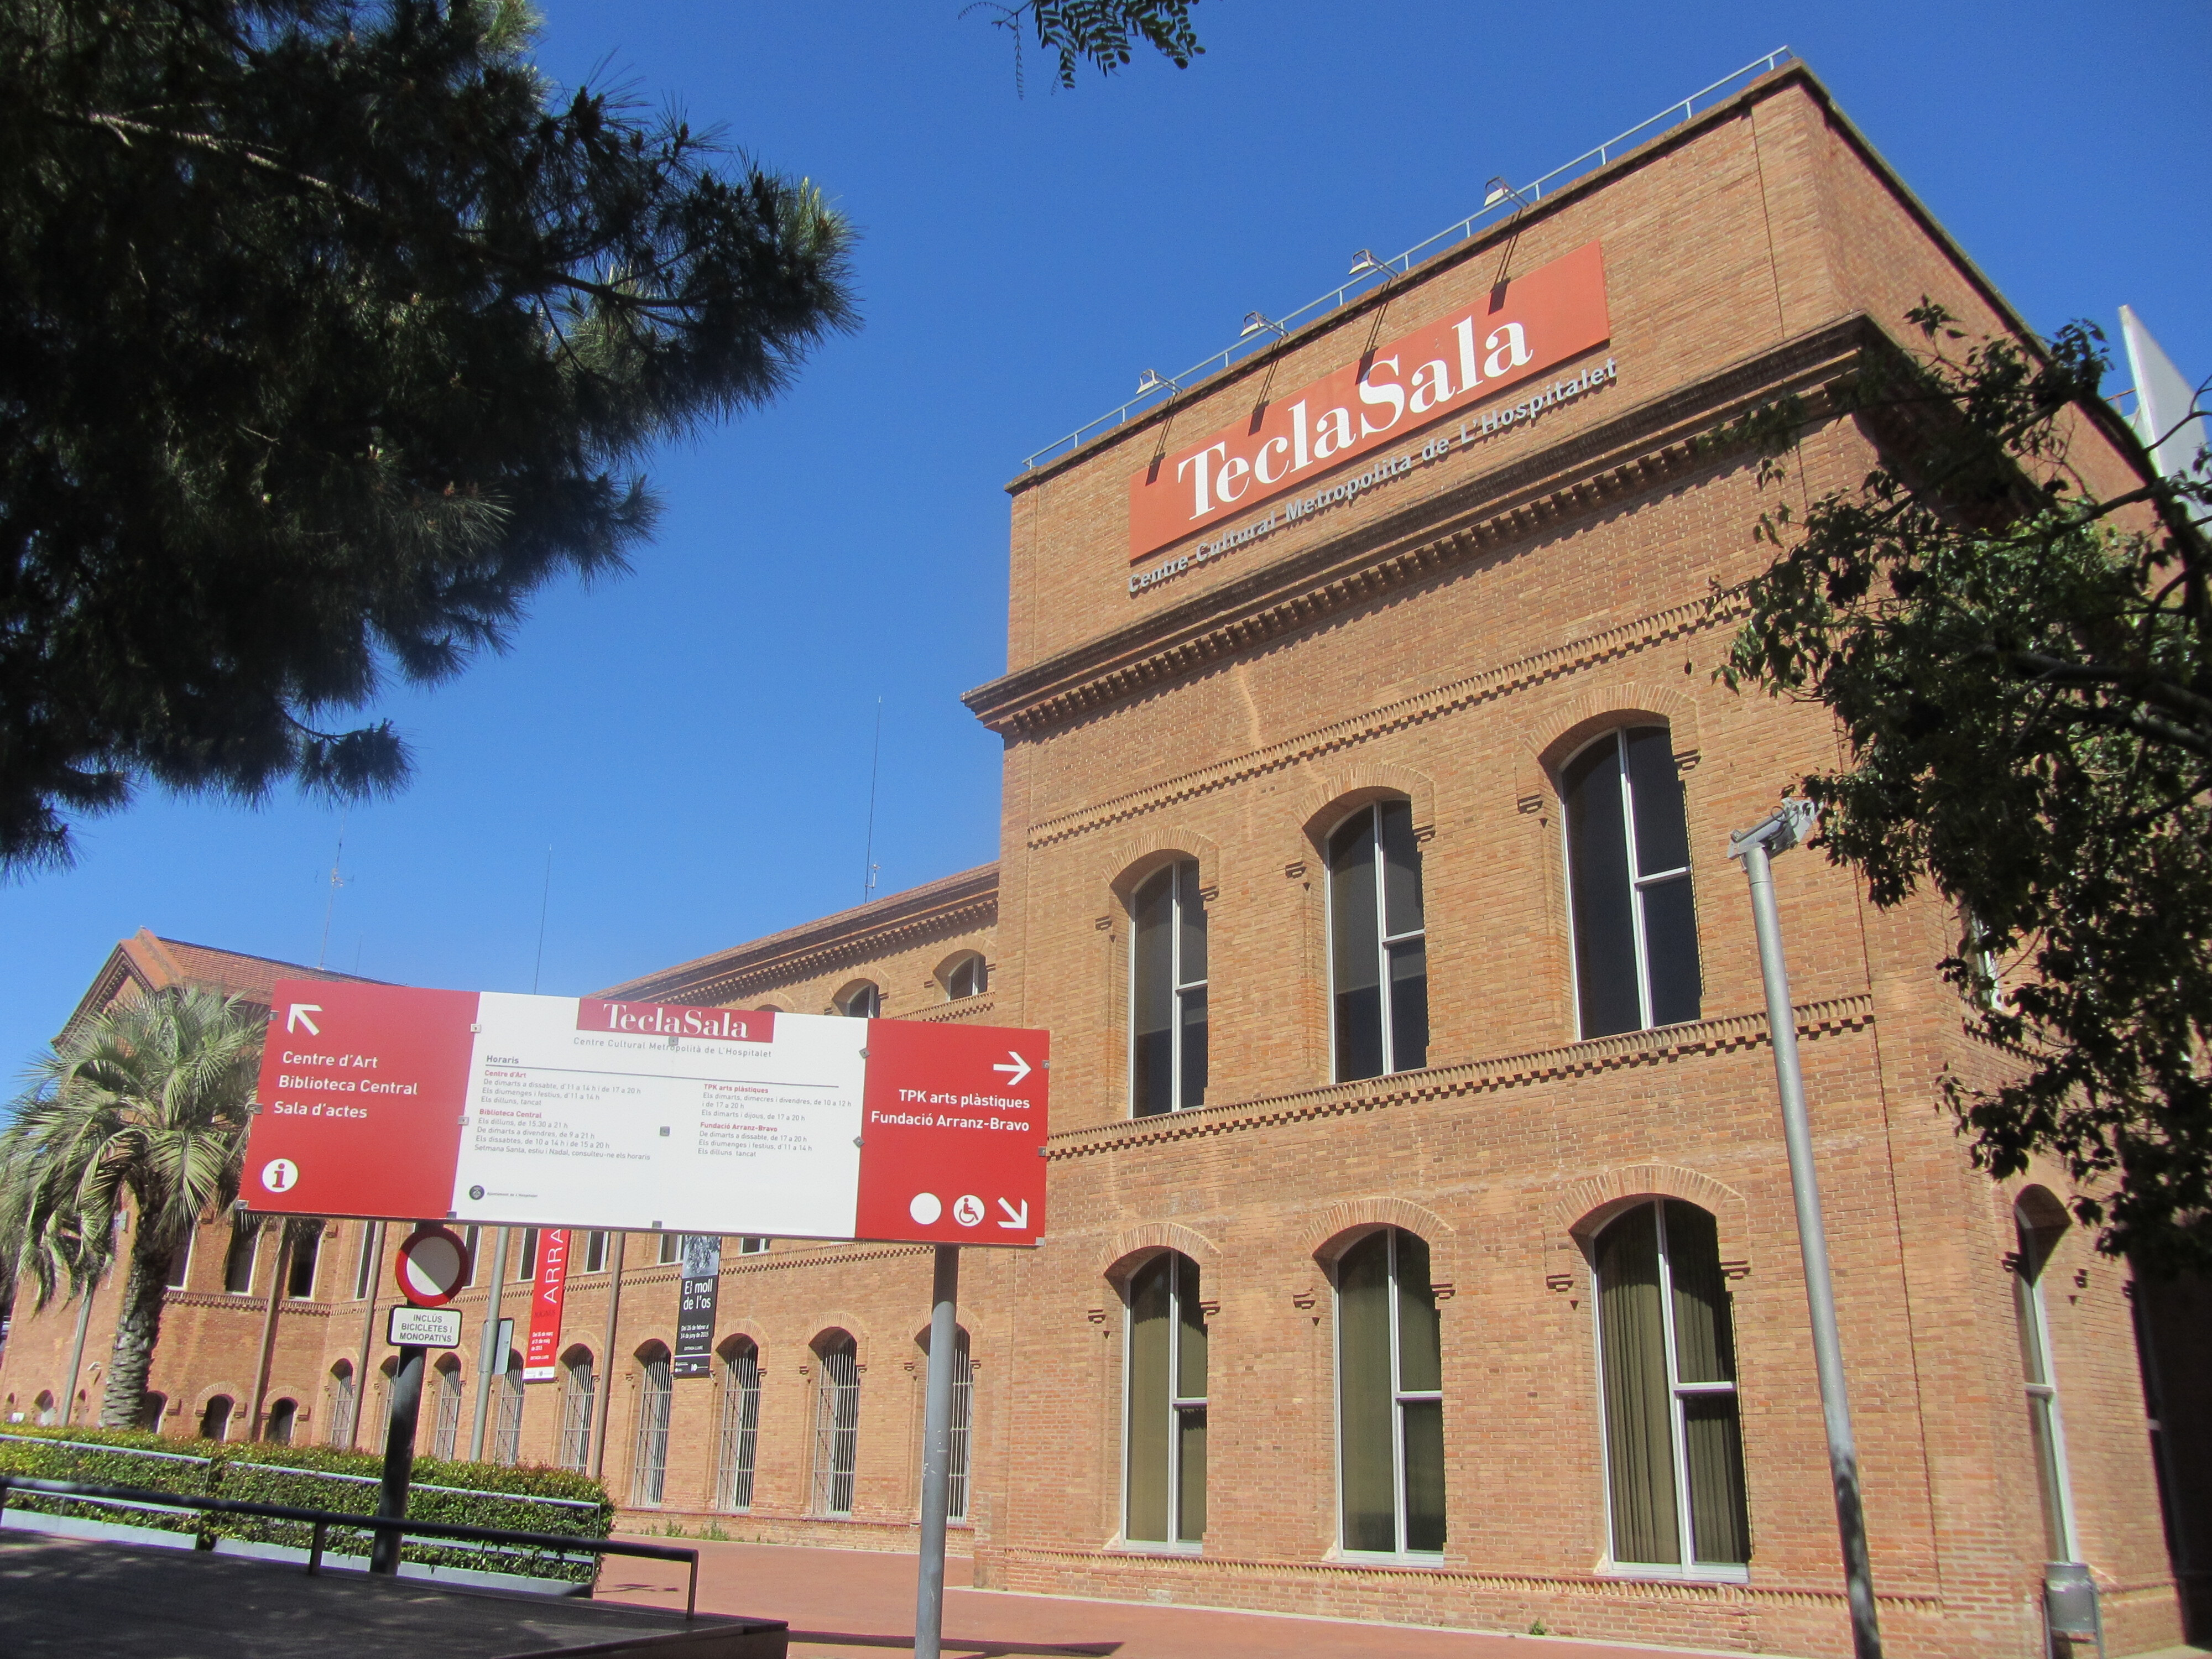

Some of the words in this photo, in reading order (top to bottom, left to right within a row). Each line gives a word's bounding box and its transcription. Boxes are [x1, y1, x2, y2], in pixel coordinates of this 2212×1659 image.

[1178, 315, 1533, 520] TeclaSala
[1129, 554, 1188, 593] Centre
[1196, 511, 1276, 562] Cultural
[1286, 455, 1412, 522] Metropolita
[1421, 438, 1449, 461] de
[1460, 357, 1617, 444] L'Hospitalet
[603, 1003, 749, 1038] TeclaSala
[573, 1037, 604, 1046] Centre
[608, 1039, 645, 1048] Cultural
[718, 1047, 770, 1057] L'Hospitalet
[283, 1051, 335, 1066] Centre
[339, 1054, 378, 1068] d'Art
[487, 1055, 519, 1064] Horaris
[279, 1074, 355, 1091] Biblioteca
[360, 1079, 418, 1095] Central
[899, 1089, 927, 1102] TPK
[930, 1093, 957, 1104] arts
[961, 1093, 1030, 1110] plàstiques
[274, 1100, 307, 1115] Sala
[312, 1103, 367, 1118] d'actes
[871, 1110, 933, 1125] Fundació
[937, 1114, 1030, 1131] Arranz-Bravo
[684, 1280, 693, 1295] El
[695, 1278, 713, 1293] moll
[683, 1296, 693, 1311] de
[696, 1295, 711, 1310] l'os
[413, 1313, 442, 1323] INCLÚS
[401, 1323, 448, 1332] BICICLETES
[399, 1332, 452, 1342] MONOPATINS
